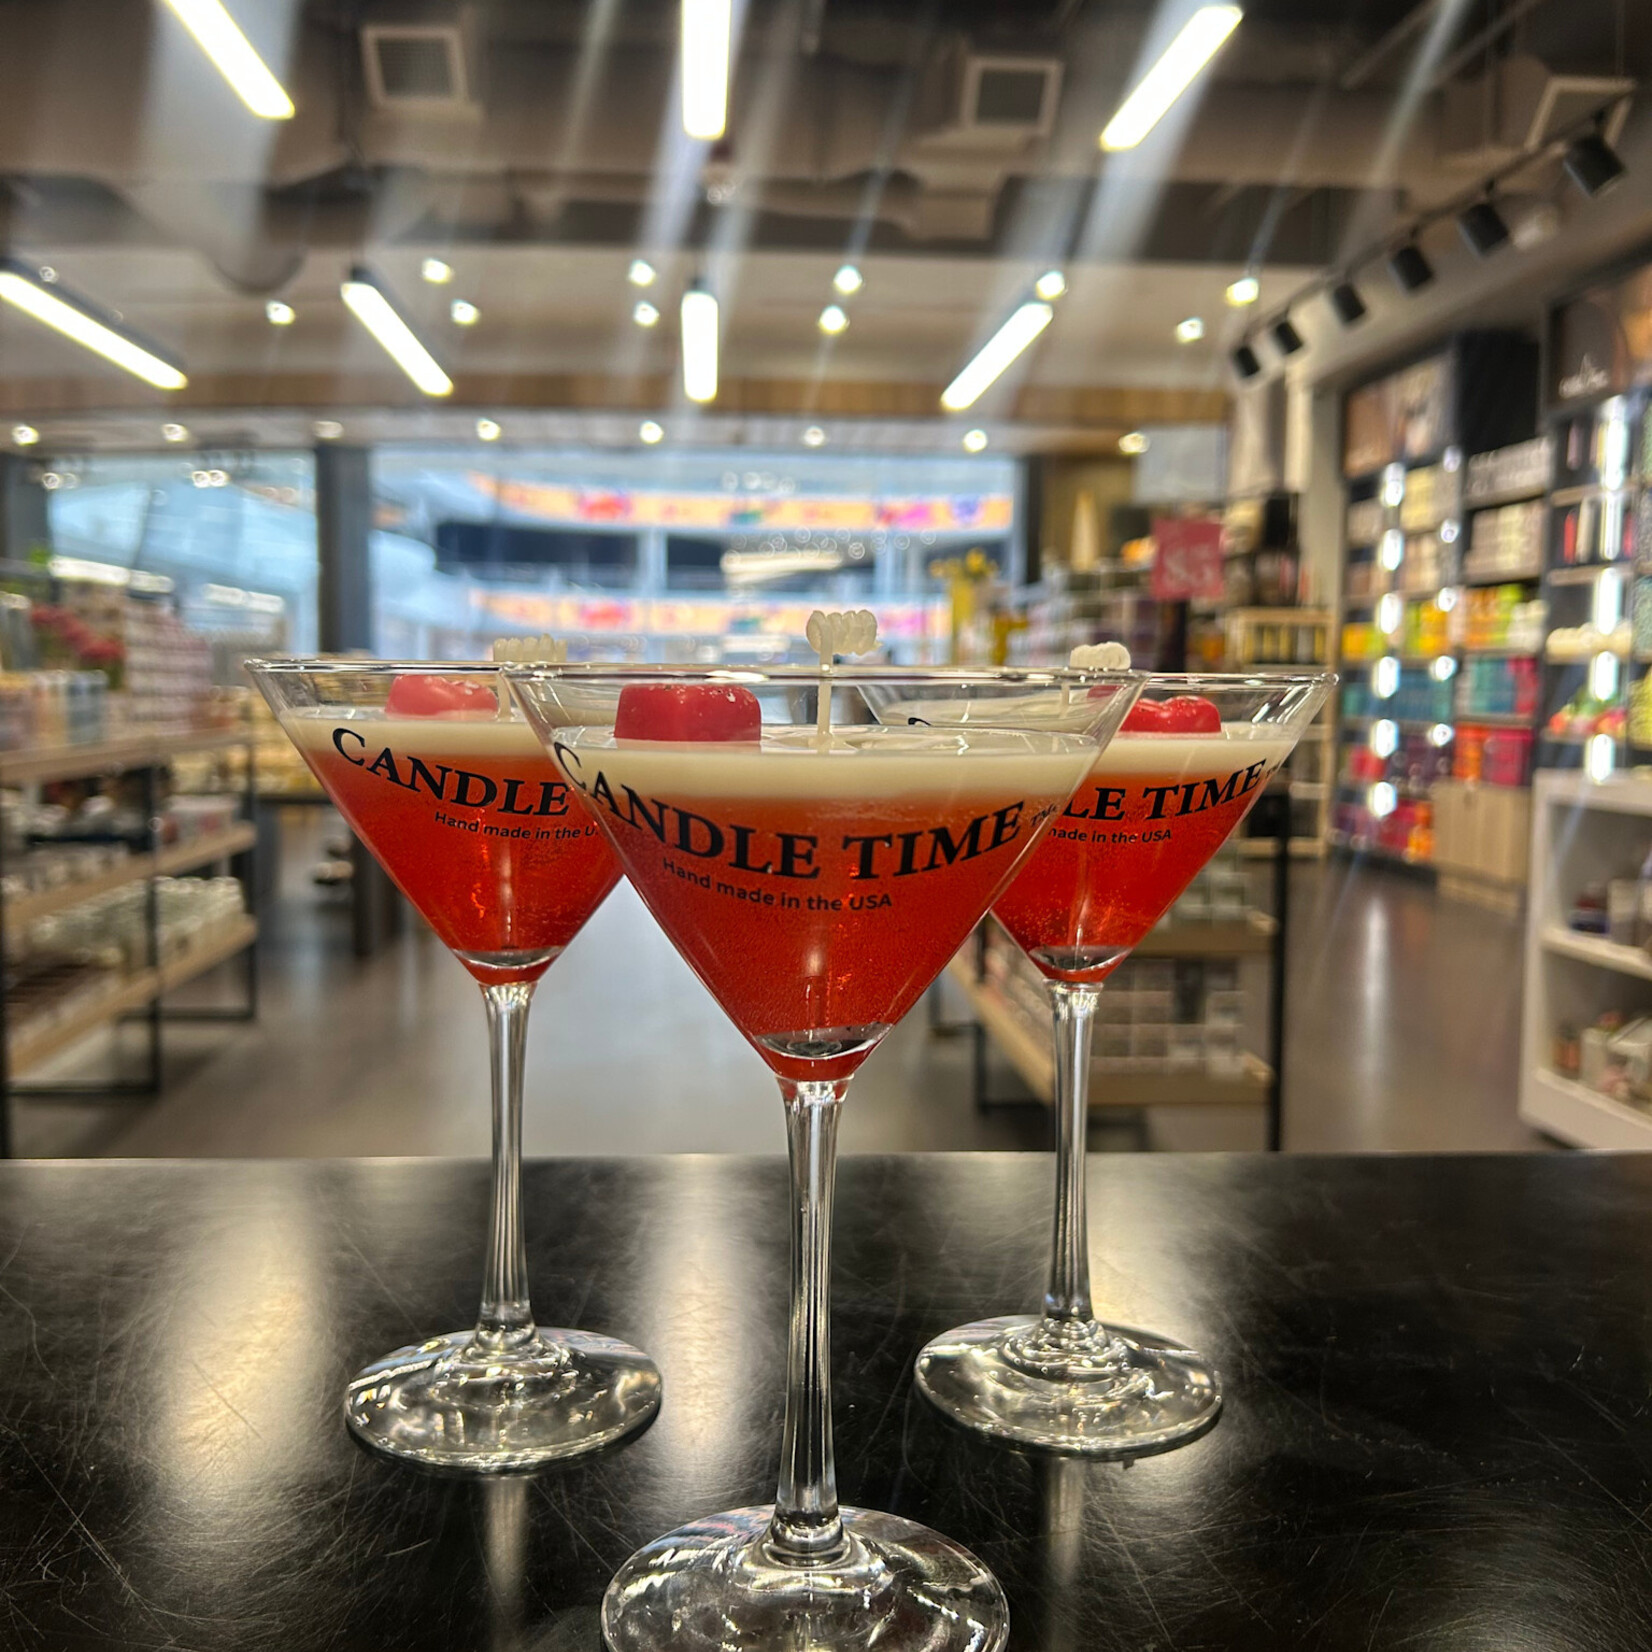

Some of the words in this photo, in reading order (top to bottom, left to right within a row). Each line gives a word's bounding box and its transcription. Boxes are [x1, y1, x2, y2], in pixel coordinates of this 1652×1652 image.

[332, 728, 571, 816] CANDLE
[1142, 758, 1266, 820] TIME
[434, 811, 479, 833] Hand
[484, 826, 531, 839] made
[535, 827, 551, 839] in
[555, 827, 581, 839] the
[554, 742, 821, 879] CANDLE
[842, 801, 1024, 880] TIME
[1092, 831, 1107, 843] in
[1112, 833, 1138, 843] the
[1141, 829, 1171, 843] USA
[663, 857, 711, 889] Hand
[717, 880, 775, 906] made
[781, 892, 800, 909] in
[807, 894, 843, 911] the
[850, 893, 893, 911] USA
